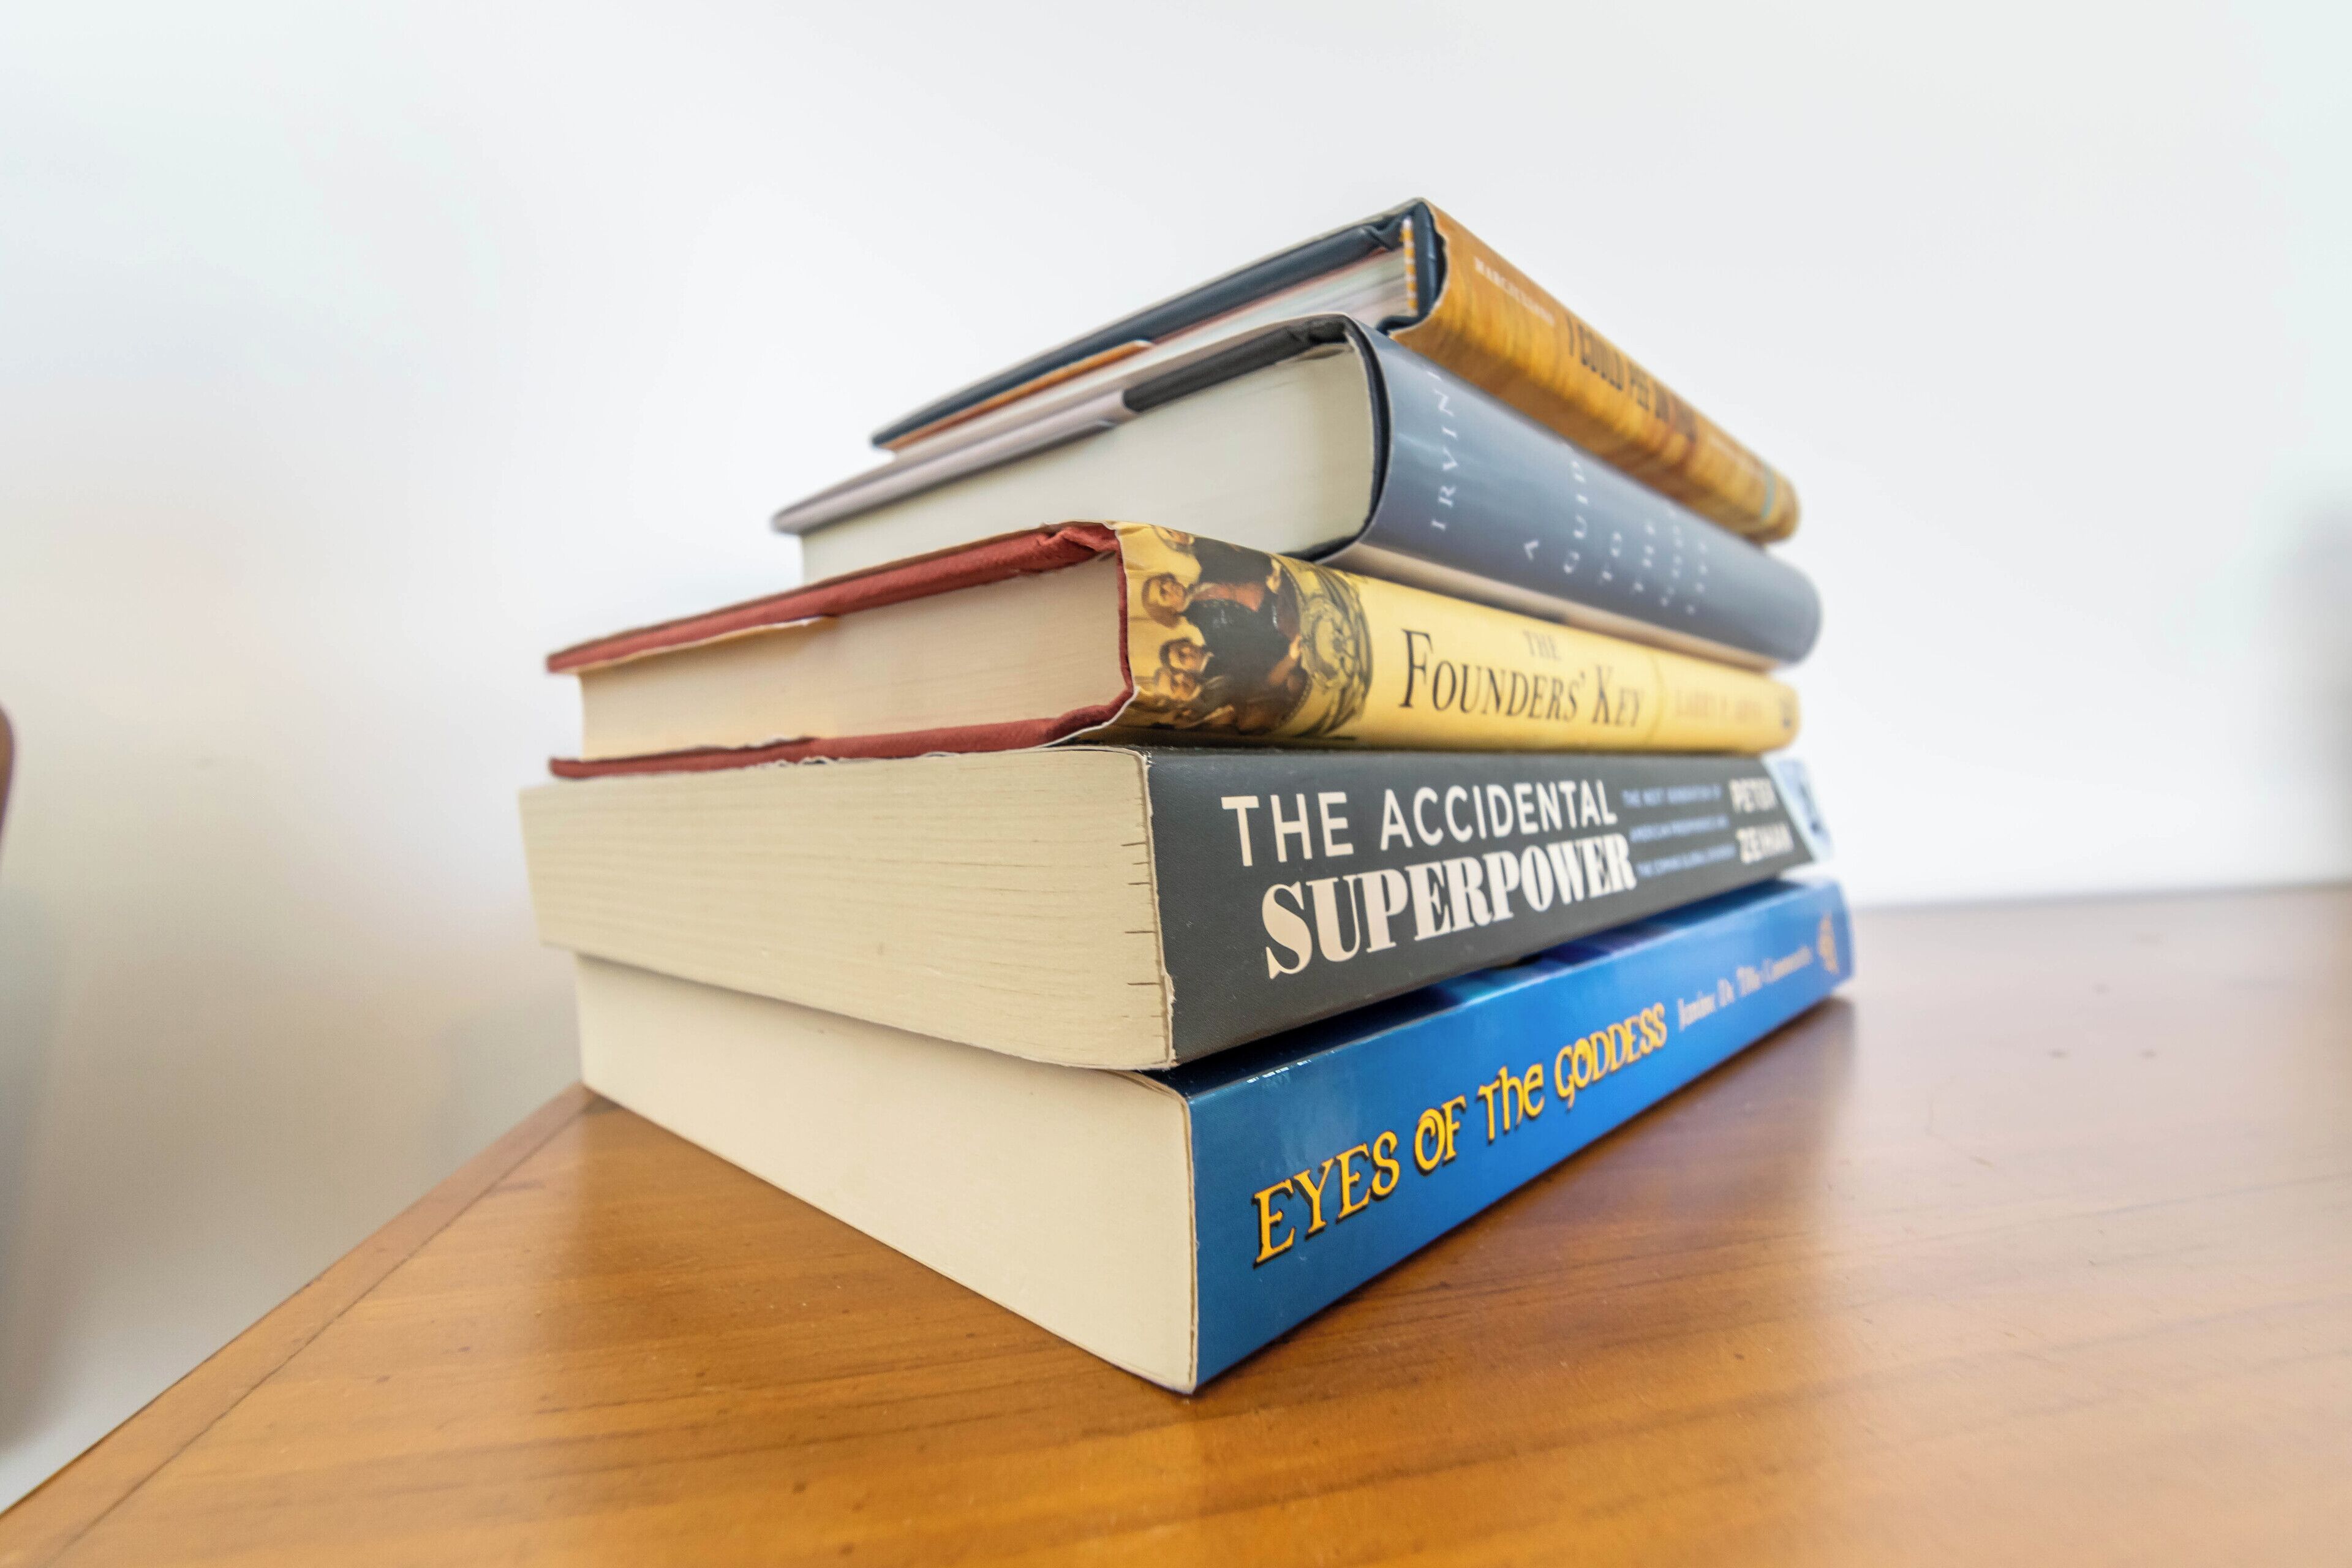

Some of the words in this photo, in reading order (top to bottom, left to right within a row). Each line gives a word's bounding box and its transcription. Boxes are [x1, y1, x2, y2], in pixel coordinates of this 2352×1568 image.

[1523, 629, 1562, 661] THE
[1221, 791, 1354, 867] THE
[1379, 779, 1618, 851] ACCIDENTAL
[1261, 833, 1638, 979] SUPERPOWER
[1253, 1130, 1401, 1265] EYES
[1414, 1095, 1467, 1176] OF
[1553, 1001, 1668, 1114] GODDESS
